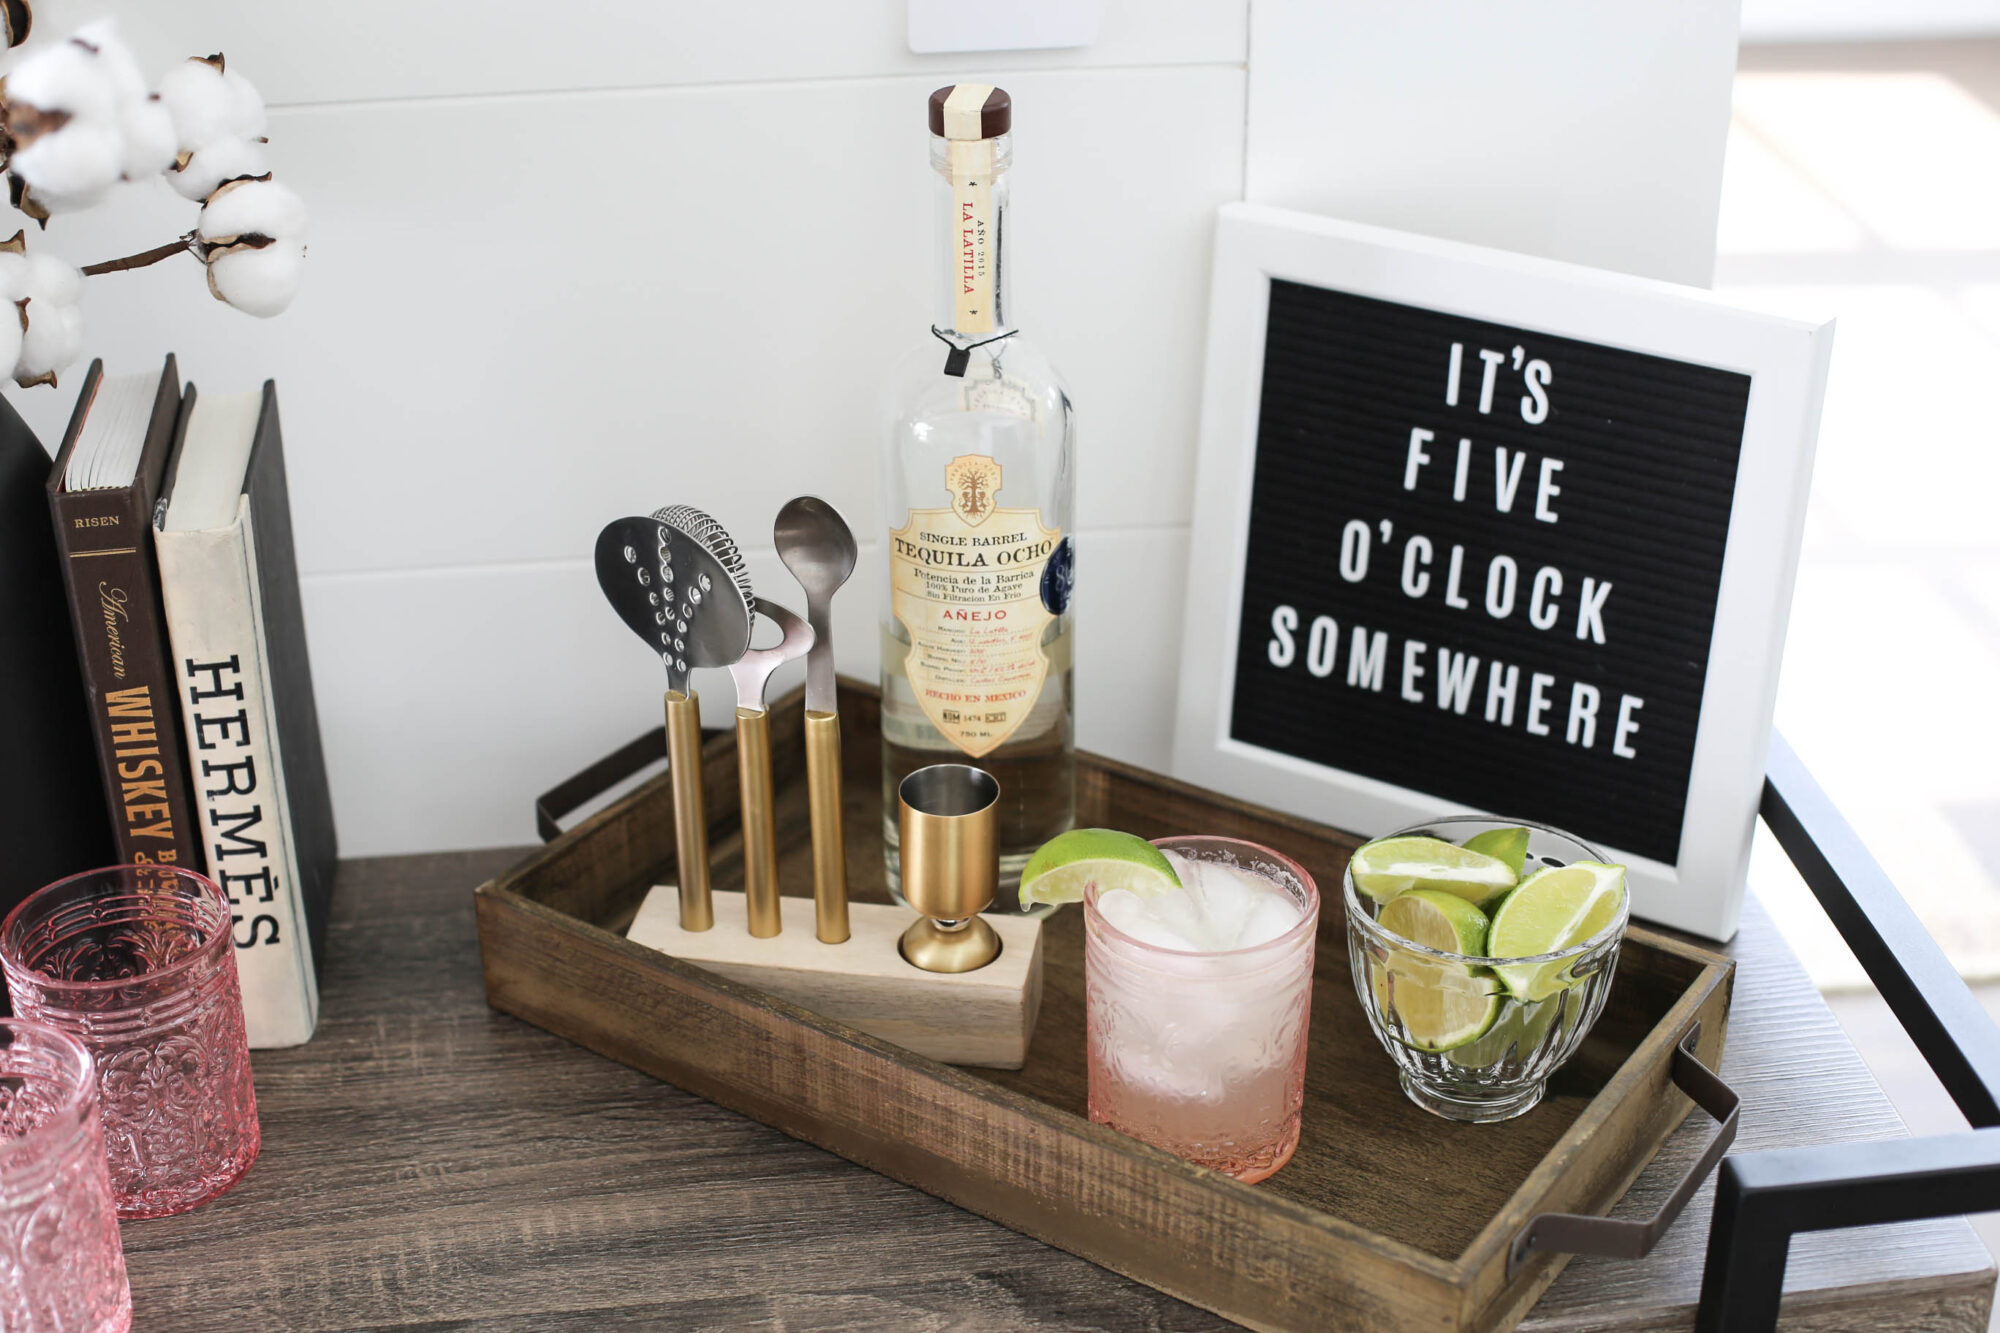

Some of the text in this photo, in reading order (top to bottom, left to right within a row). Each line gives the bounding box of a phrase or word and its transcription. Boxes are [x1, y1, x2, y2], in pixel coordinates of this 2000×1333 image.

[962, 202, 975, 295] LA LATILLA
[977, 220, 986, 245] AÑO
[1445, 342, 1552, 425] IT'S
[1404, 427, 1564, 523] FIVE
[74, 515, 120, 529] RISEN
[920, 531, 1028, 547] SINGLE BARREL
[895, 537, 1052, 567] TEQUILA OCHO
[914, 568, 1034, 586] Potencia de la Barrica
[926, 581, 1023, 594] 100% Puro de Agave
[1339, 519, 1612, 645] O'CLOCK
[98, 580, 130, 680] American
[942, 608, 1007, 622] AÑEJO
[925, 688, 1026, 703] HECHO EN MEXICO
[1268, 605, 1644, 759] SOMEWHERE
[104, 684, 175, 840] WHISKEY
[185, 654, 281, 950] HERMÈS
